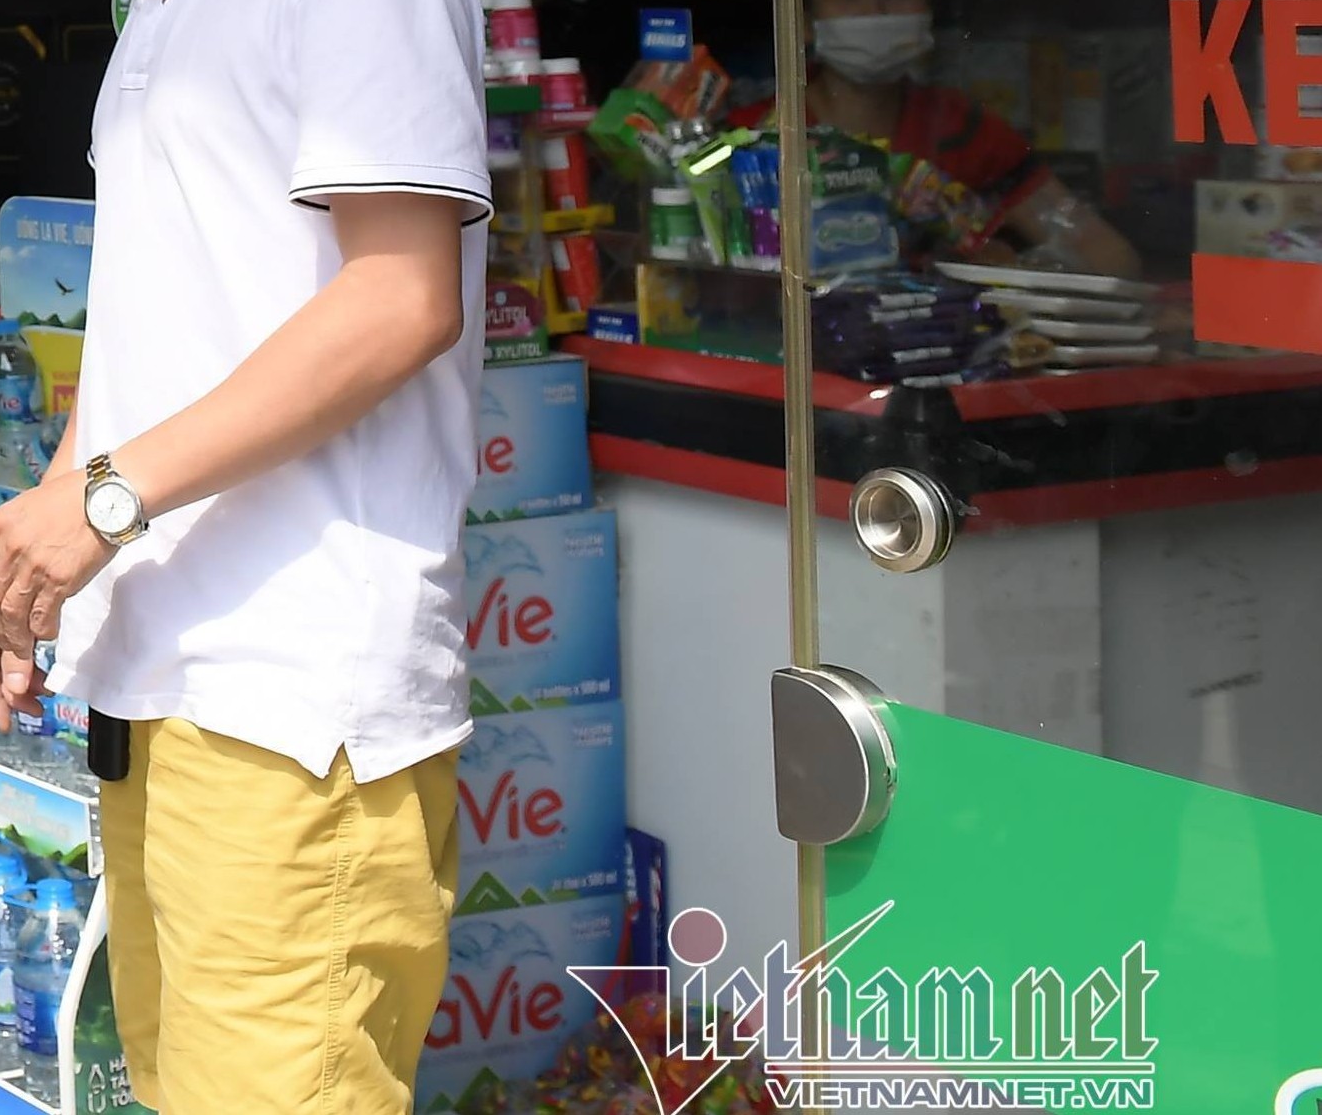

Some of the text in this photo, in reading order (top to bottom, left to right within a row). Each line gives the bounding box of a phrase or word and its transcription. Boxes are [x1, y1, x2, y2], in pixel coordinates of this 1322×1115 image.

[466, 577, 555, 652] Vie
[457, 769, 564, 845] Vie
[424, 965, 565, 1051] aVie
